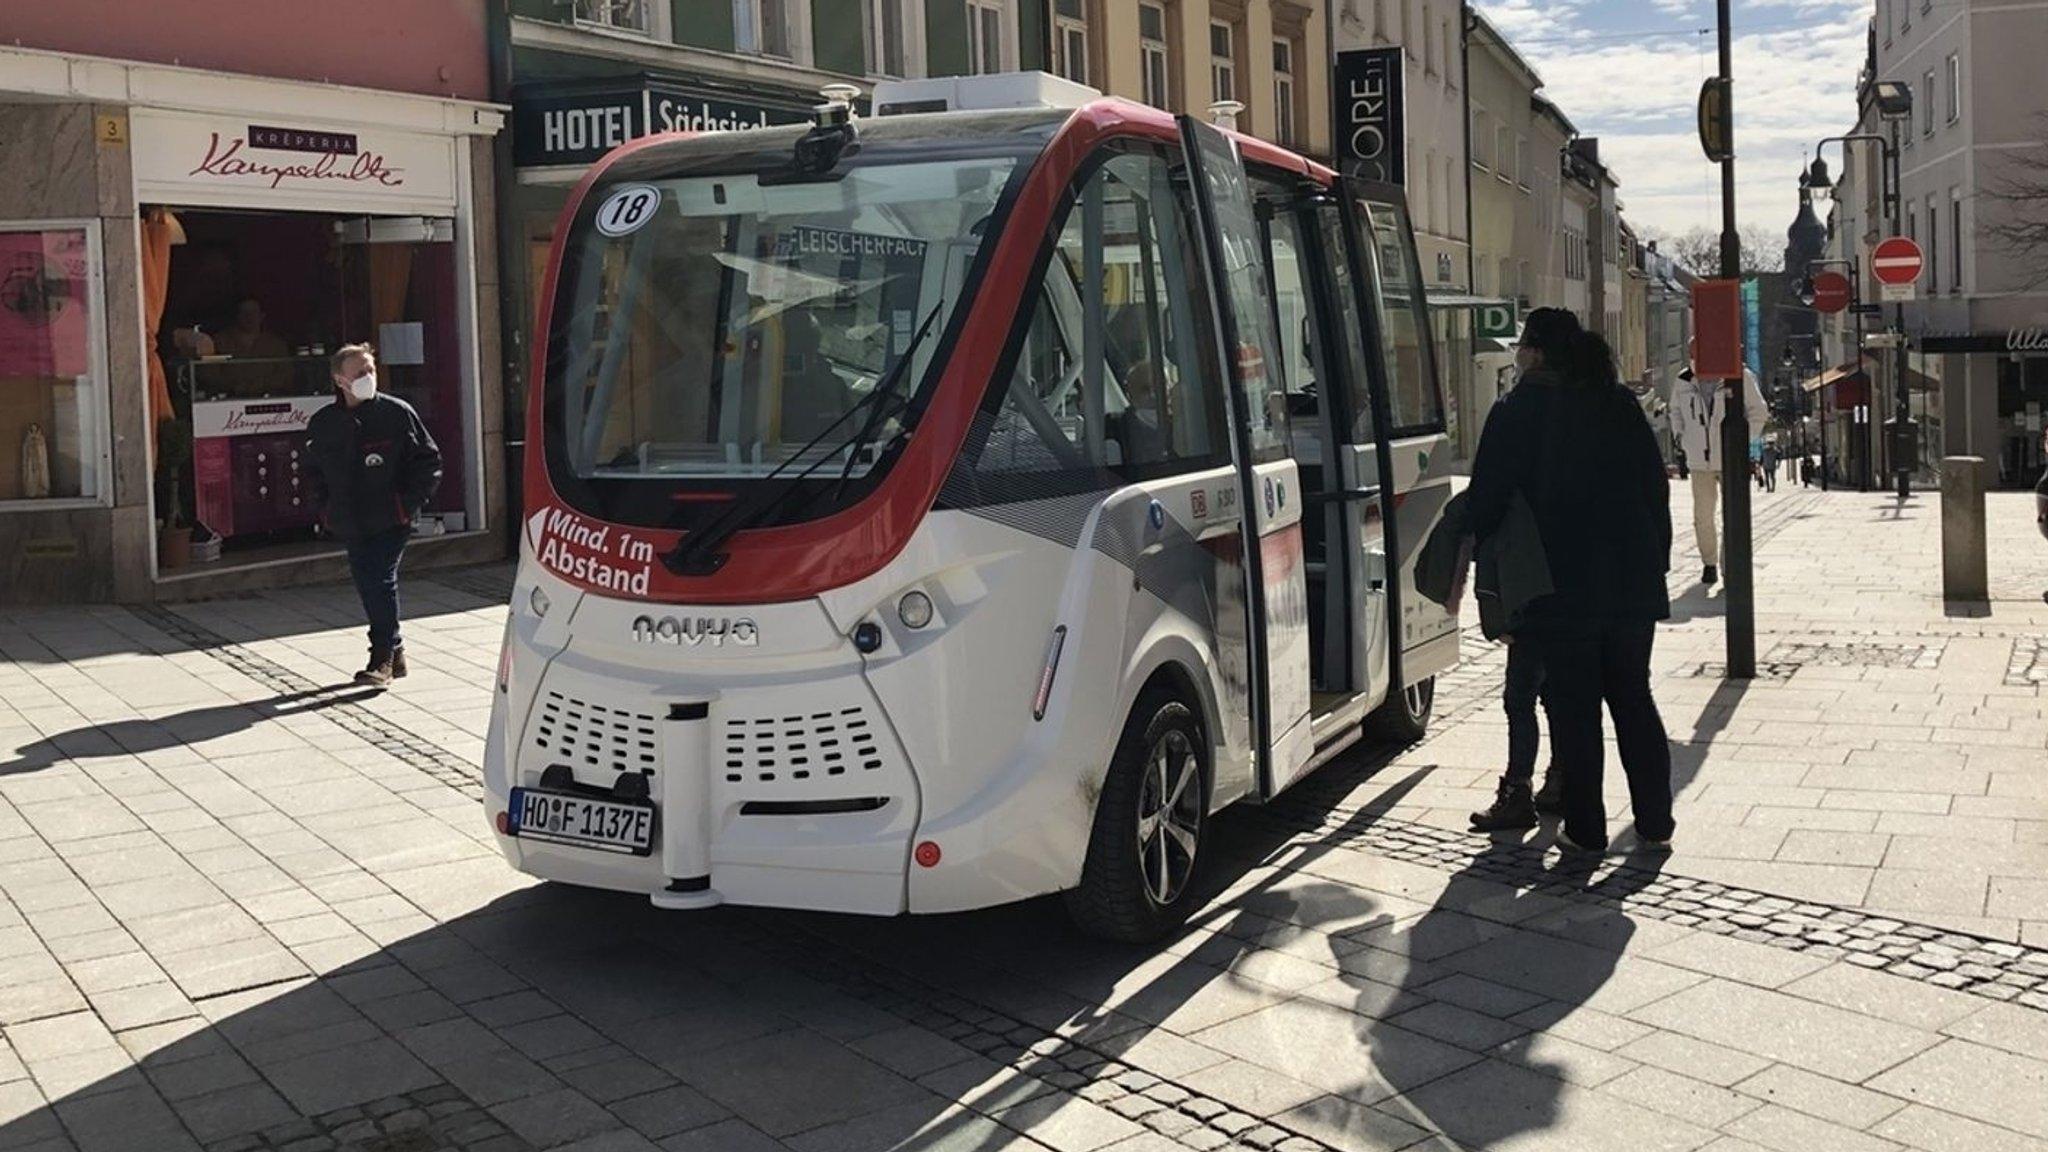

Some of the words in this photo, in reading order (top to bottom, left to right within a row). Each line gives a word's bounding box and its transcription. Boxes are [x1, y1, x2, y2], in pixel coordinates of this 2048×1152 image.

[107, 120, 118, 136] 3
[544, 106, 632, 151] HOTEL
[189, 132, 404, 189] Kampschulte
[610, 194, 649, 225] 18
[1484, 306, 1510, 331] D
[547, 508, 609, 554] Mind.
[619, 533, 654, 563] 1m
[540, 537, 651, 596] Abstand
[523, 795, 549, 829] HO
[562, 801, 577, 831] F
[580, 804, 650, 843] 1137E
